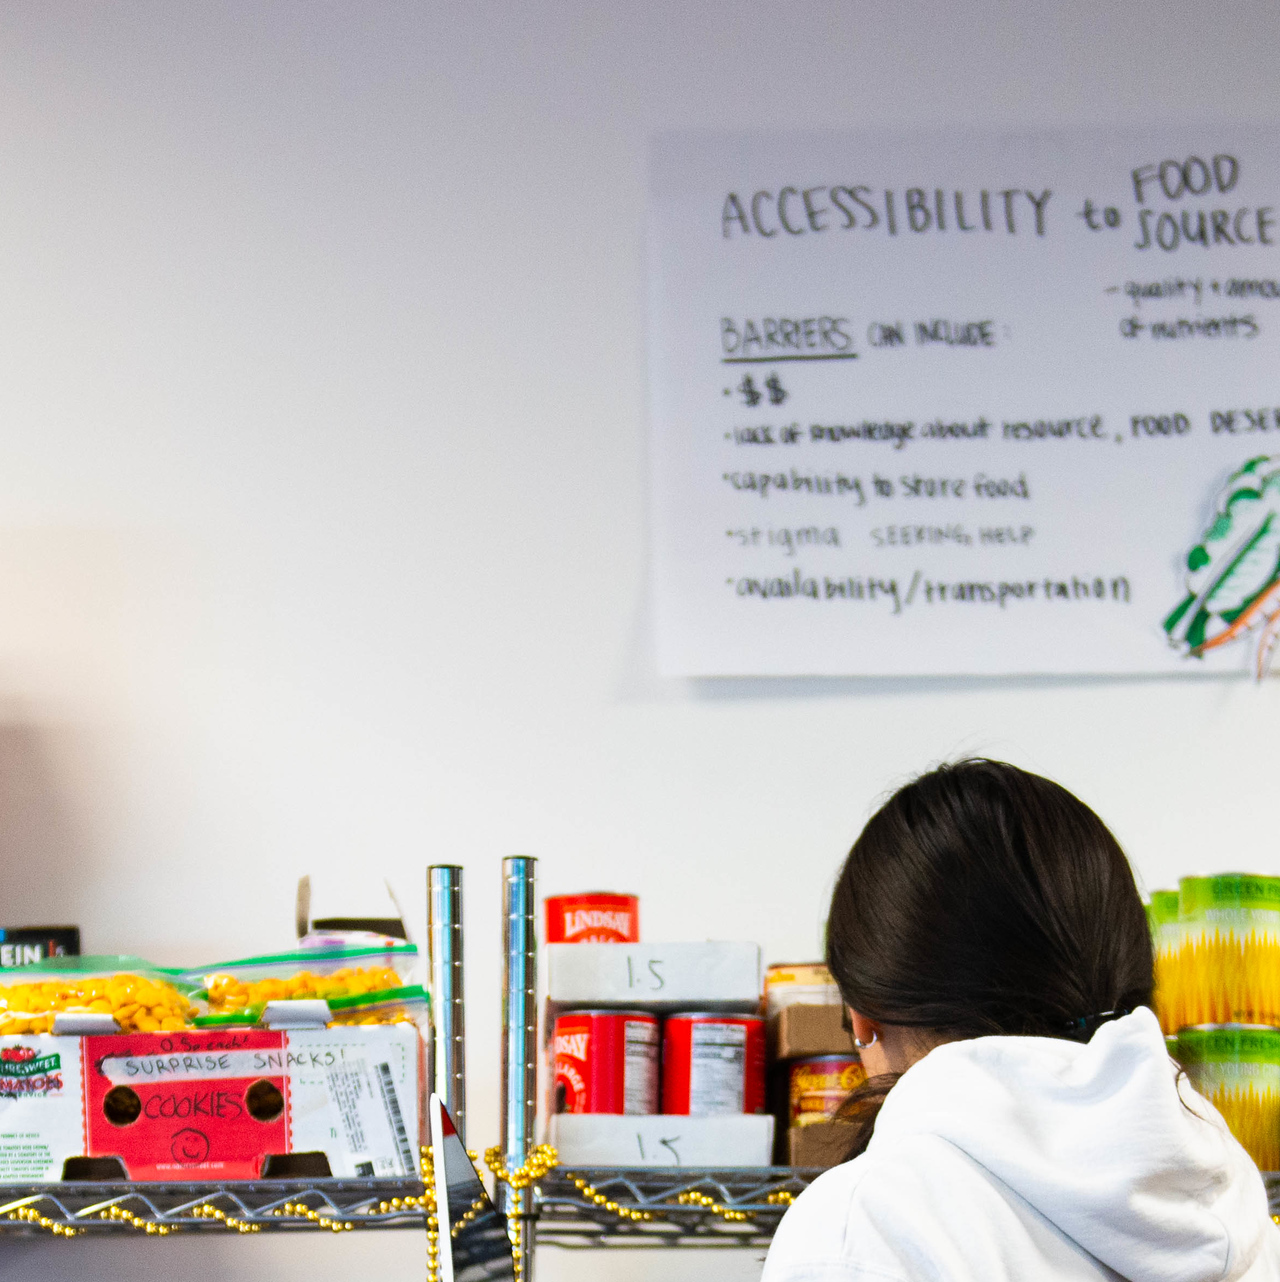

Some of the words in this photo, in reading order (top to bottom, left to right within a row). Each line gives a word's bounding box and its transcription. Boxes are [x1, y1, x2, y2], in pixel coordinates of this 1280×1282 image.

[1131, 153, 1239, 204] FOOD
[721, 185, 1053, 238] ACCESSIBILITY
[1077, 199, 1121, 231] to
[1133, 205, 1275, 251] SOURCE
[721, 316, 857, 353] BARRIERS
[868, 320, 904, 347] CAN
[810, 419, 916, 450] knowledge
[920, 414, 990, 440] about
[1130, 410, 1193, 438] FOOD
[730, 469, 866, 508] capability
[872, 472, 894, 498] to
[974, 471, 1029, 498] food
[736, 525, 840, 557] stigma
[870, 523, 973, 548] SEEKING
[977, 523, 1034, 547] HELP
[564, 909, 632, 938] LINDSAY
[125, 1054, 231, 1077] SURPRISE
[254, 1048, 346, 1069] SNACKS!
[144, 1092, 243, 1120] COOKIES
